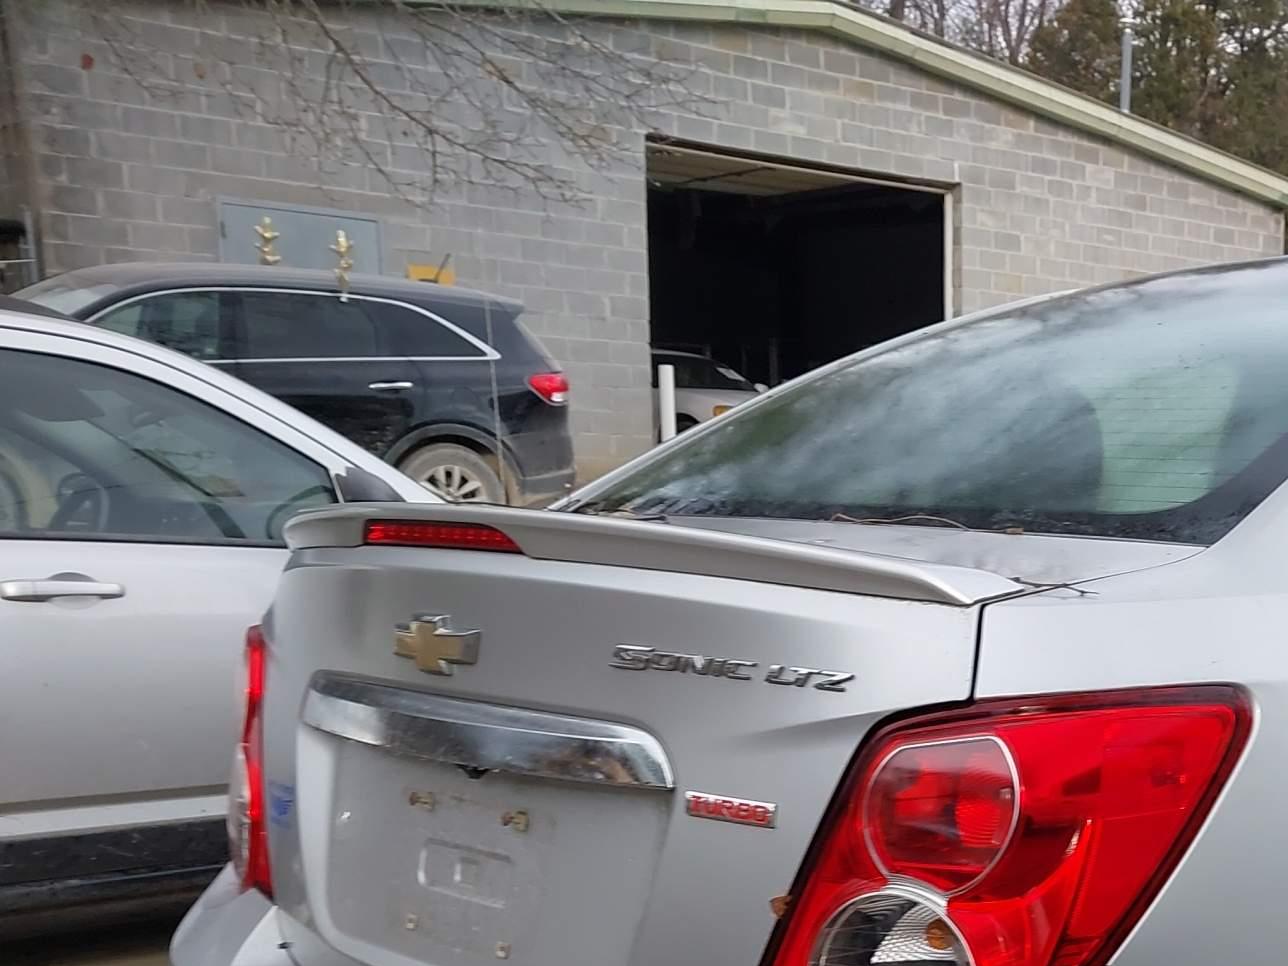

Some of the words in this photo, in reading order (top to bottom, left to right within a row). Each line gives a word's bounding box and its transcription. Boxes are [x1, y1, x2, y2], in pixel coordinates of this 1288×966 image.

[608, 644, 759, 681] SONIC
[764, 664, 855, 692] LTZ
[686, 792, 774, 826] TURBO
